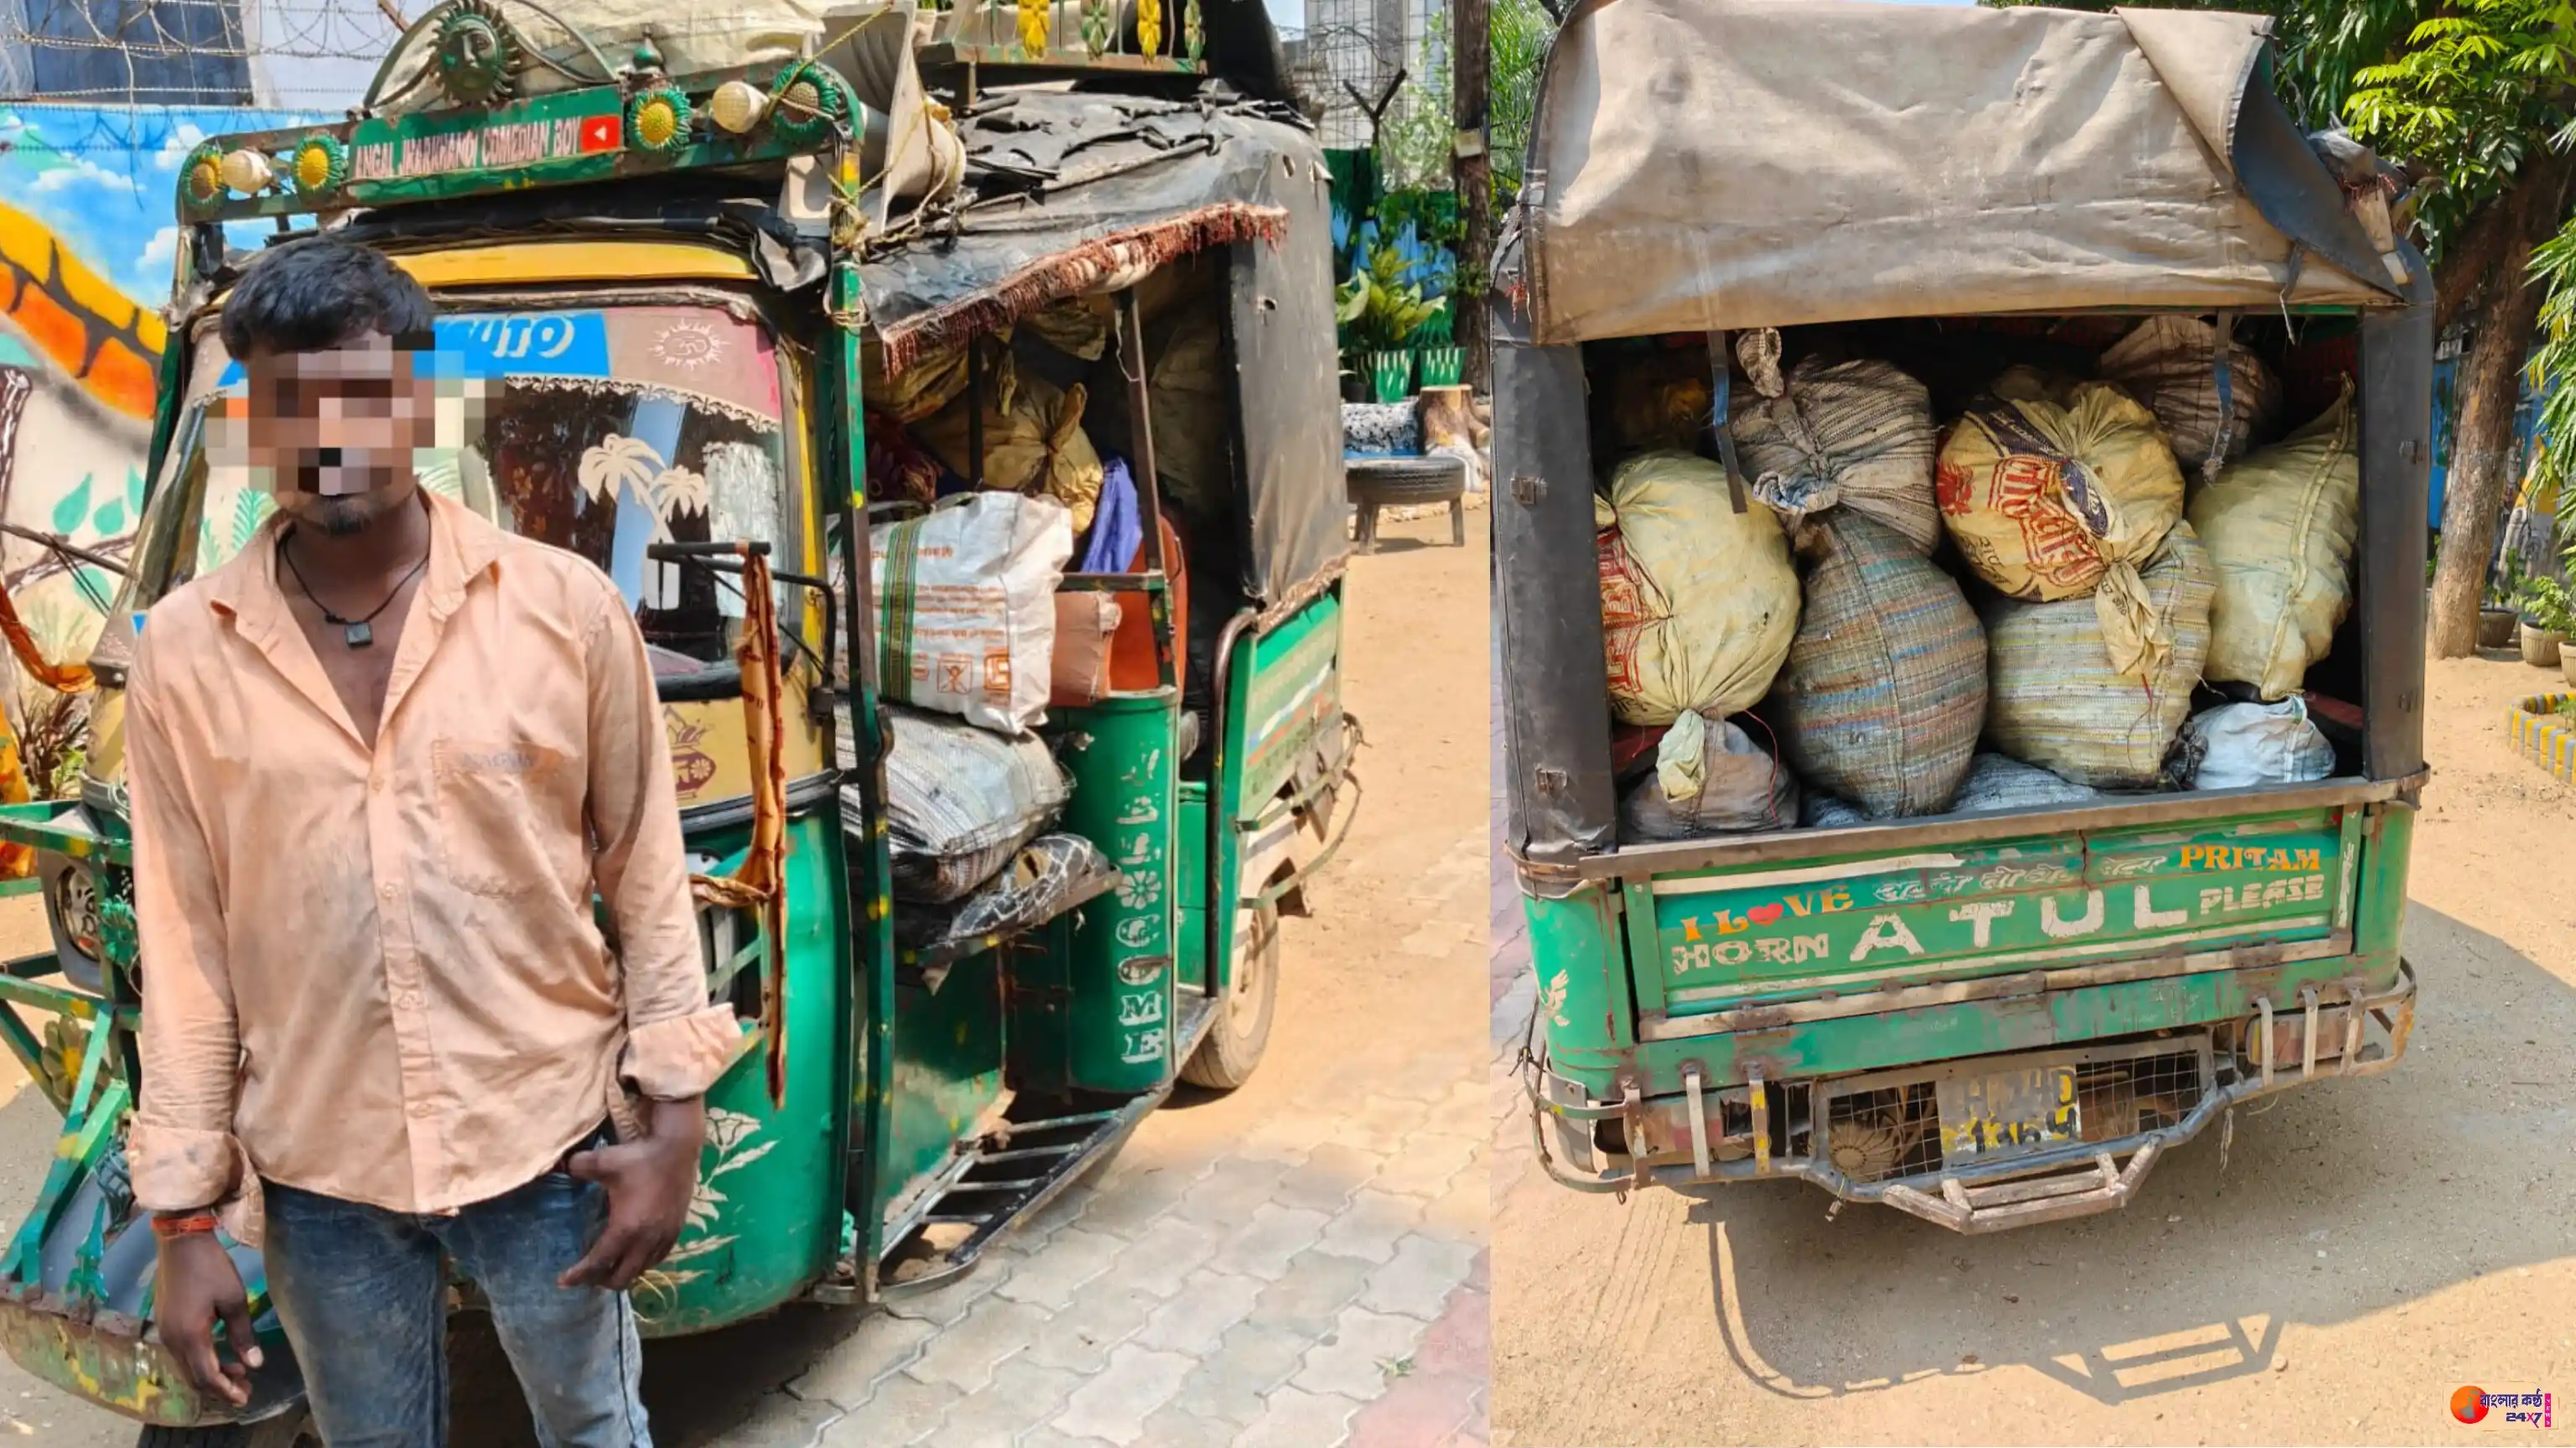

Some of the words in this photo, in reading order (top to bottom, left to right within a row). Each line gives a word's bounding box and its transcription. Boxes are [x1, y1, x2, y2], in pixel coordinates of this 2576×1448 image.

[481, 120, 550, 167] COMEDIAN
[553, 116, 582, 158] BOY
[1671, 933, 1830, 975] HORN
[1850, 884, 2189, 962] ATUL
[2199, 875, 2325, 916] PLEASE
[1680, 916, 1702, 942] I
[2179, 844, 2321, 872] PRITAM
